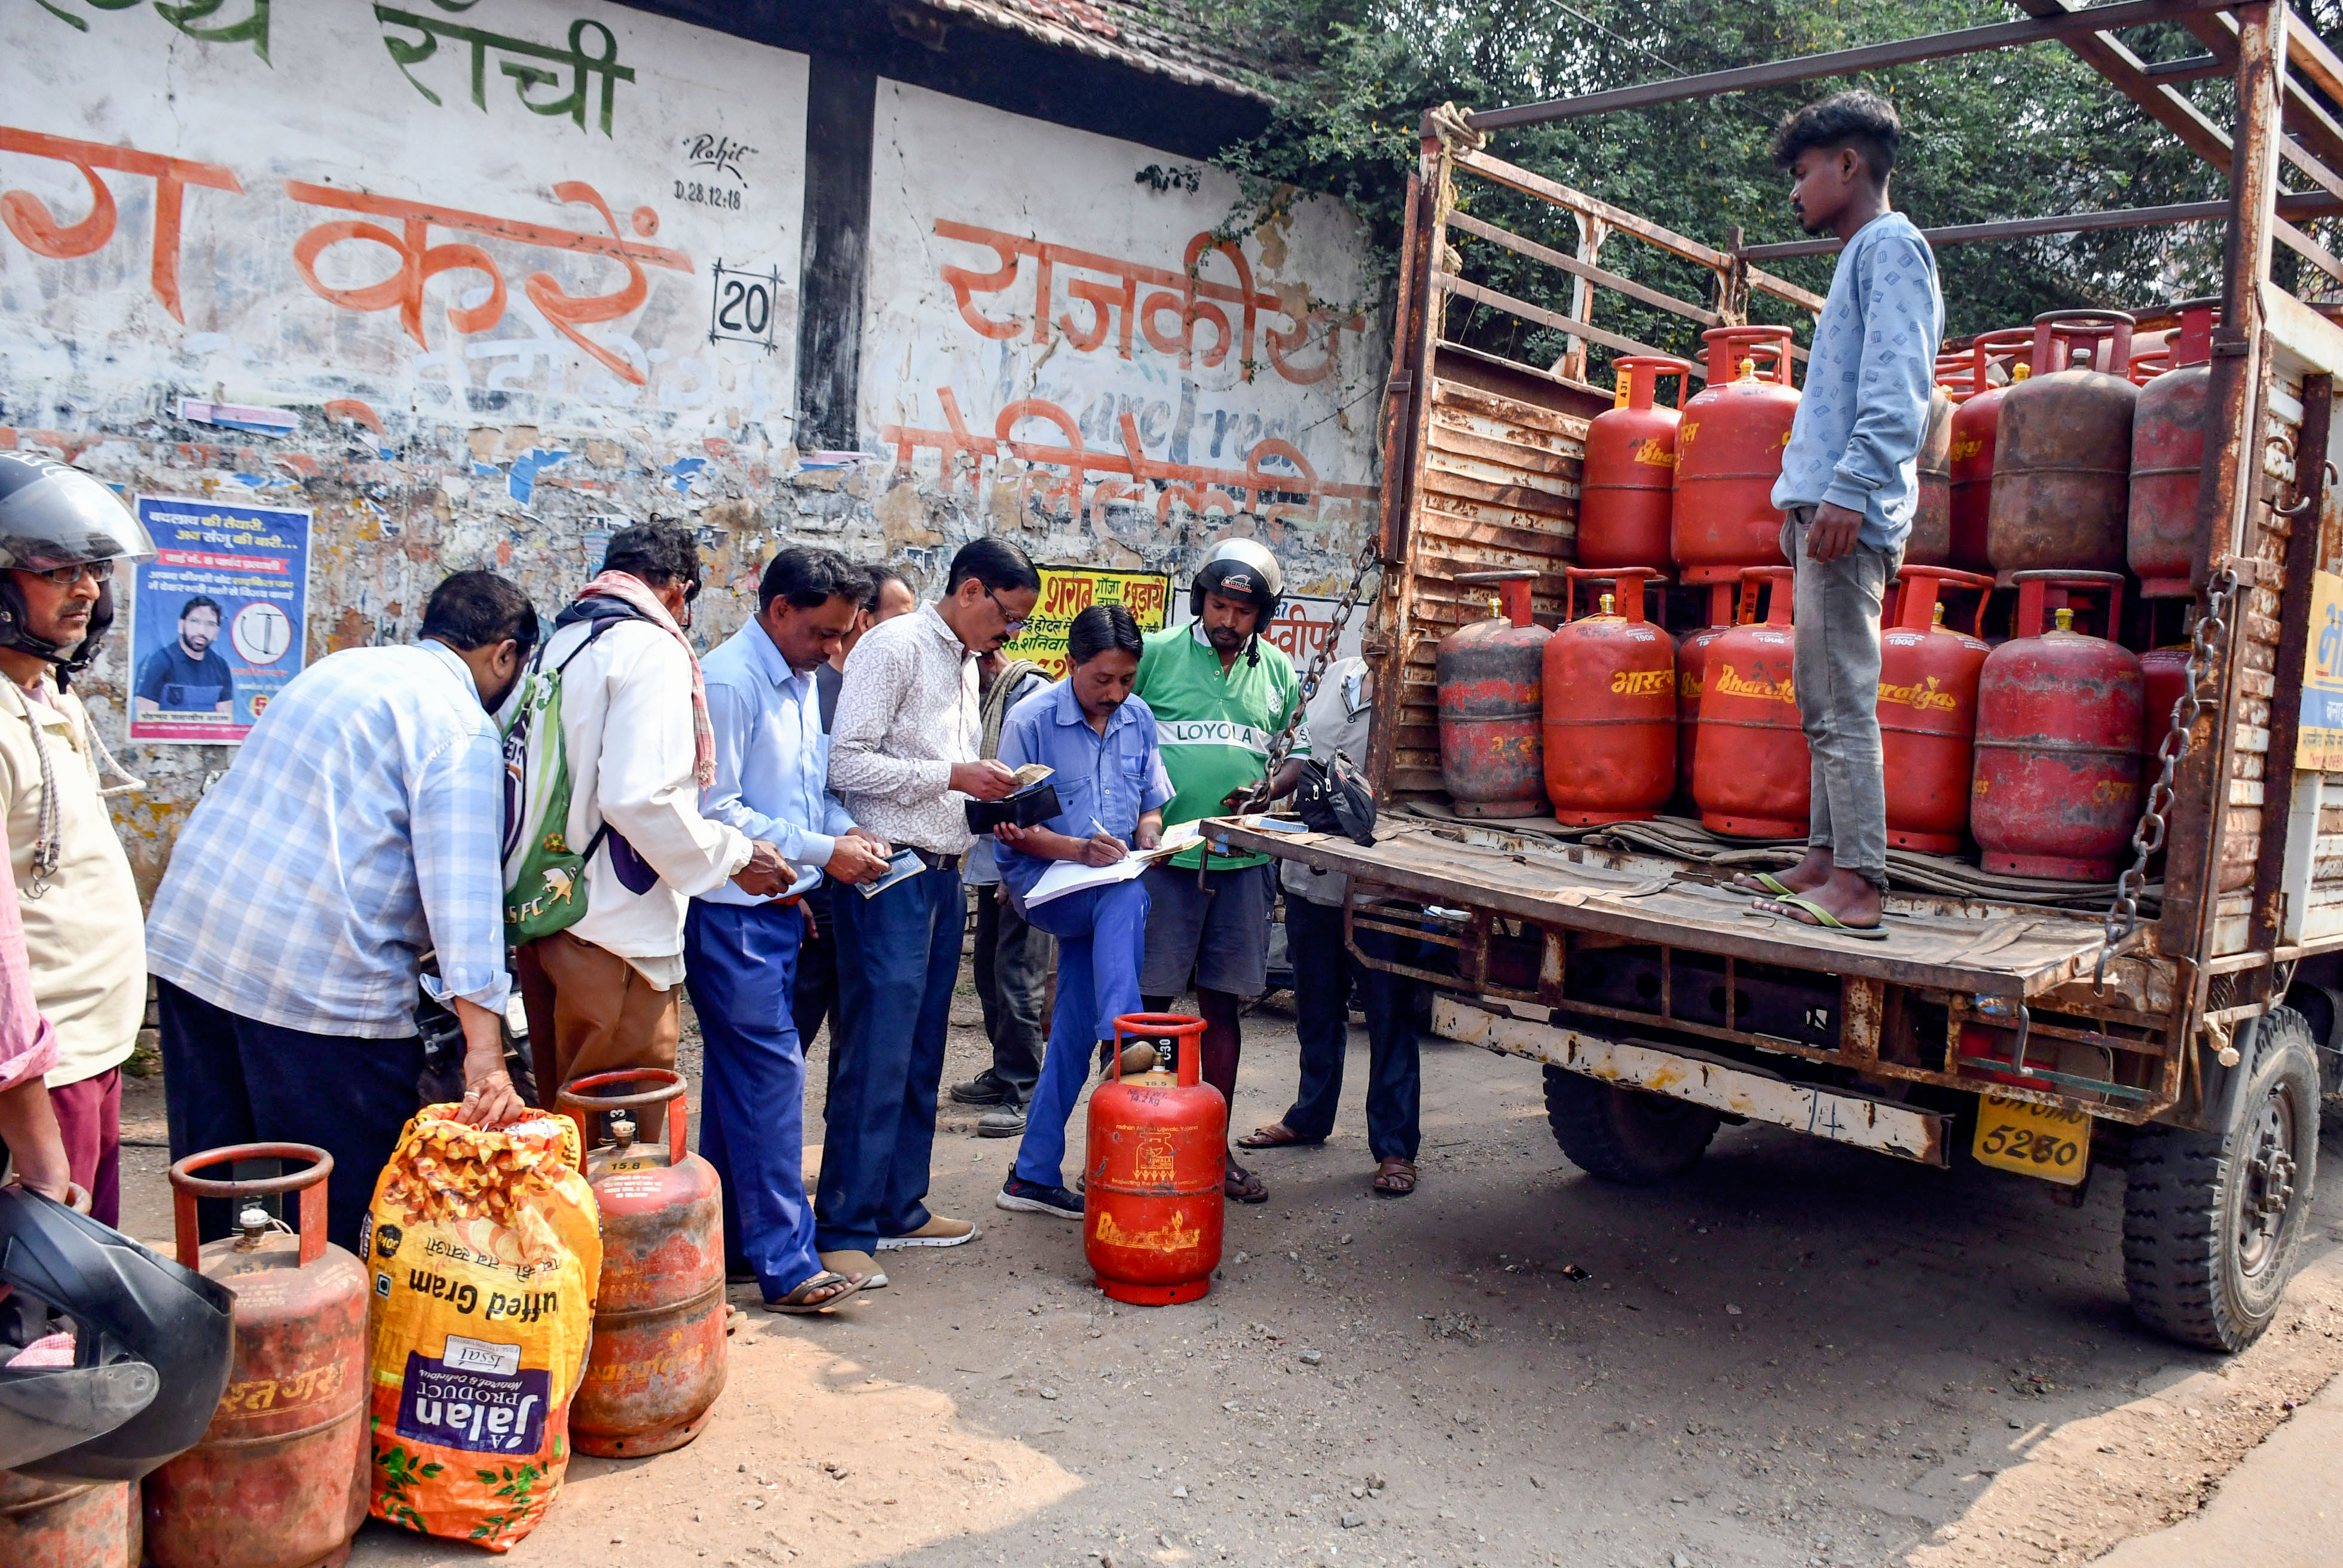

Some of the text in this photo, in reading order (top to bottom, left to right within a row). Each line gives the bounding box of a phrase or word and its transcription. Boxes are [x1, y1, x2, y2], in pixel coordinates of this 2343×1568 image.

[280, 178, 695, 385] करें
[719, 280, 770, 334] 20
[935, 218, 1367, 386] राजकीय
[1045, 576, 1093, 620] शराब
[1889, 638, 1915, 647] 1906
[1177, 722, 1252, 745] LOYOLA
[520, 896, 544, 923] FC
[611, 1162, 641, 1170] 15.8
[409, 1268, 478, 1315] Gram
[459, 1347, 505, 1371] fssai
[469, 1376, 478, 1385] &
[477, 1378, 523, 1391] Natural
[416, 1382, 520, 1405] PRODUCT
[489, 1434, 507, 1449] A
